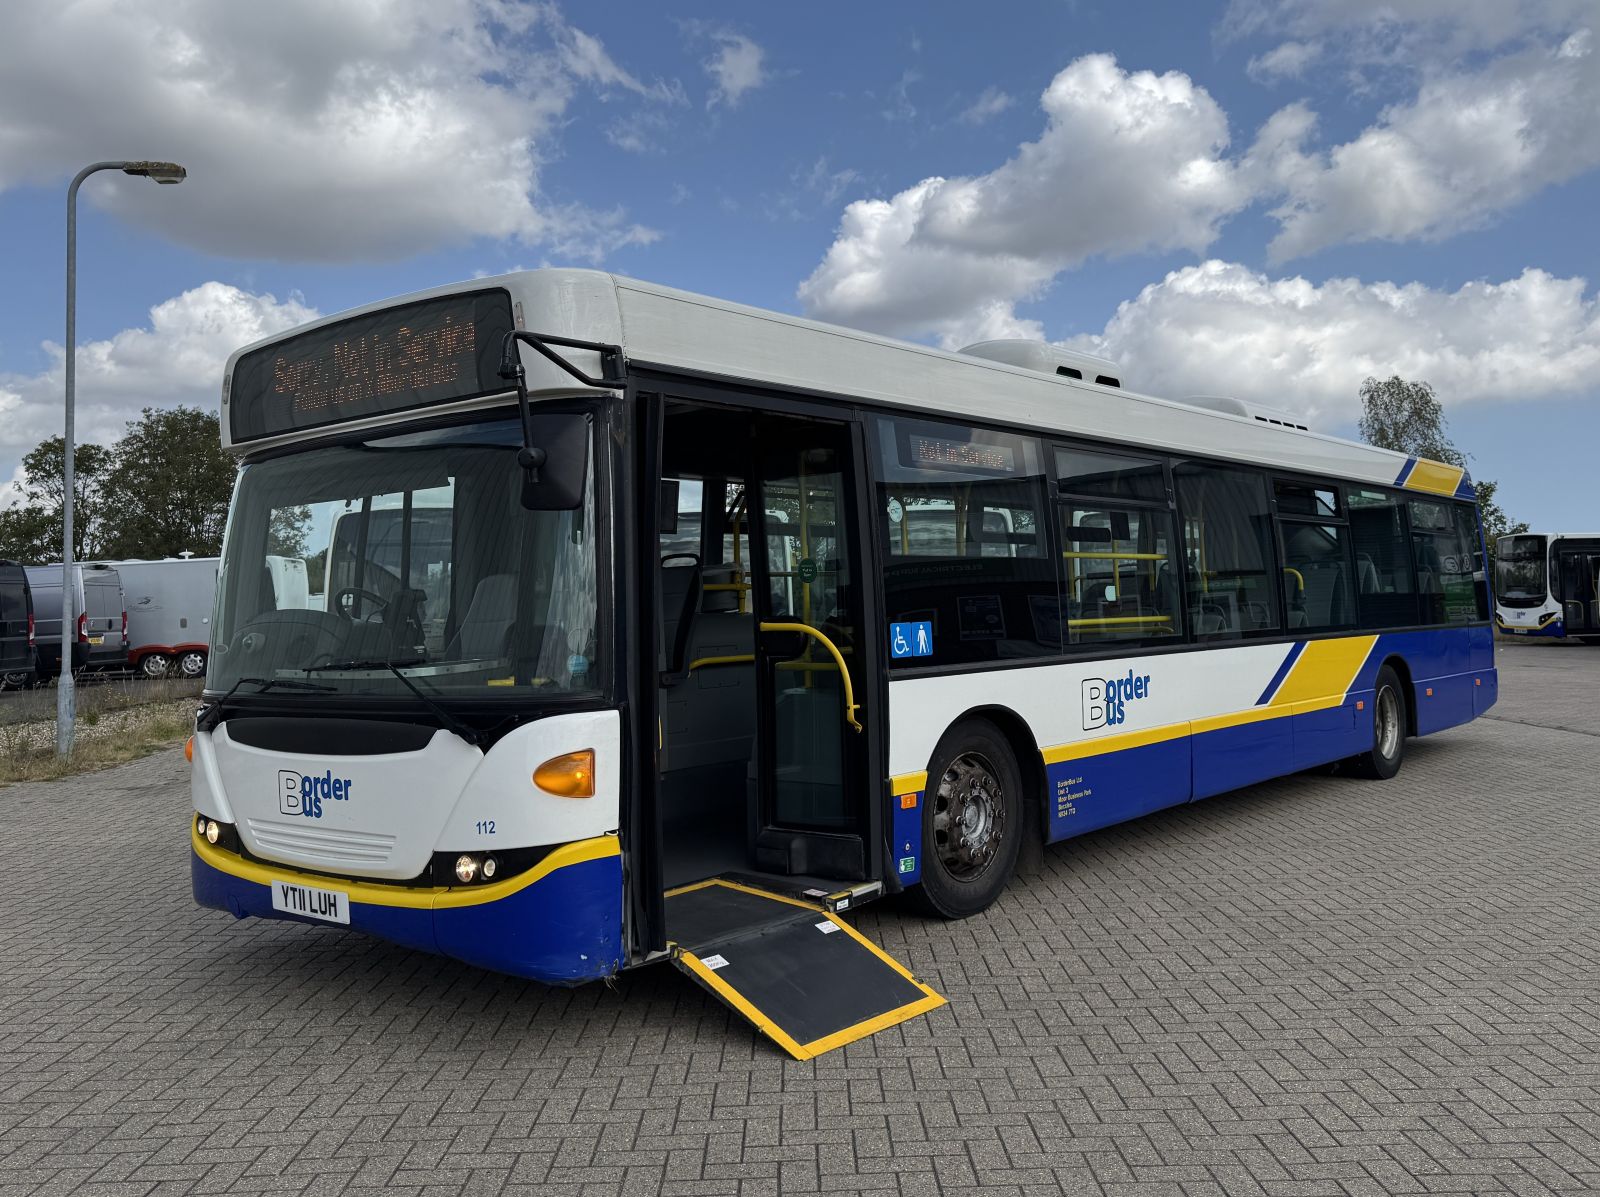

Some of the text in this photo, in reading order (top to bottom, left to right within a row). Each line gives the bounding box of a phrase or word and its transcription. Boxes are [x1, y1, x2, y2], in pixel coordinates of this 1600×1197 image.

[334, 337, 368, 377] Not
[374, 334, 391, 371] in
[398, 316, 475, 366] Service
[919, 440, 1004, 468] Not in Service
[1081, 669, 1150, 731] Border
[278, 769, 351, 815] Border
[476, 820, 497, 835] 112
[281, 884, 338, 918] YT11 LUH
